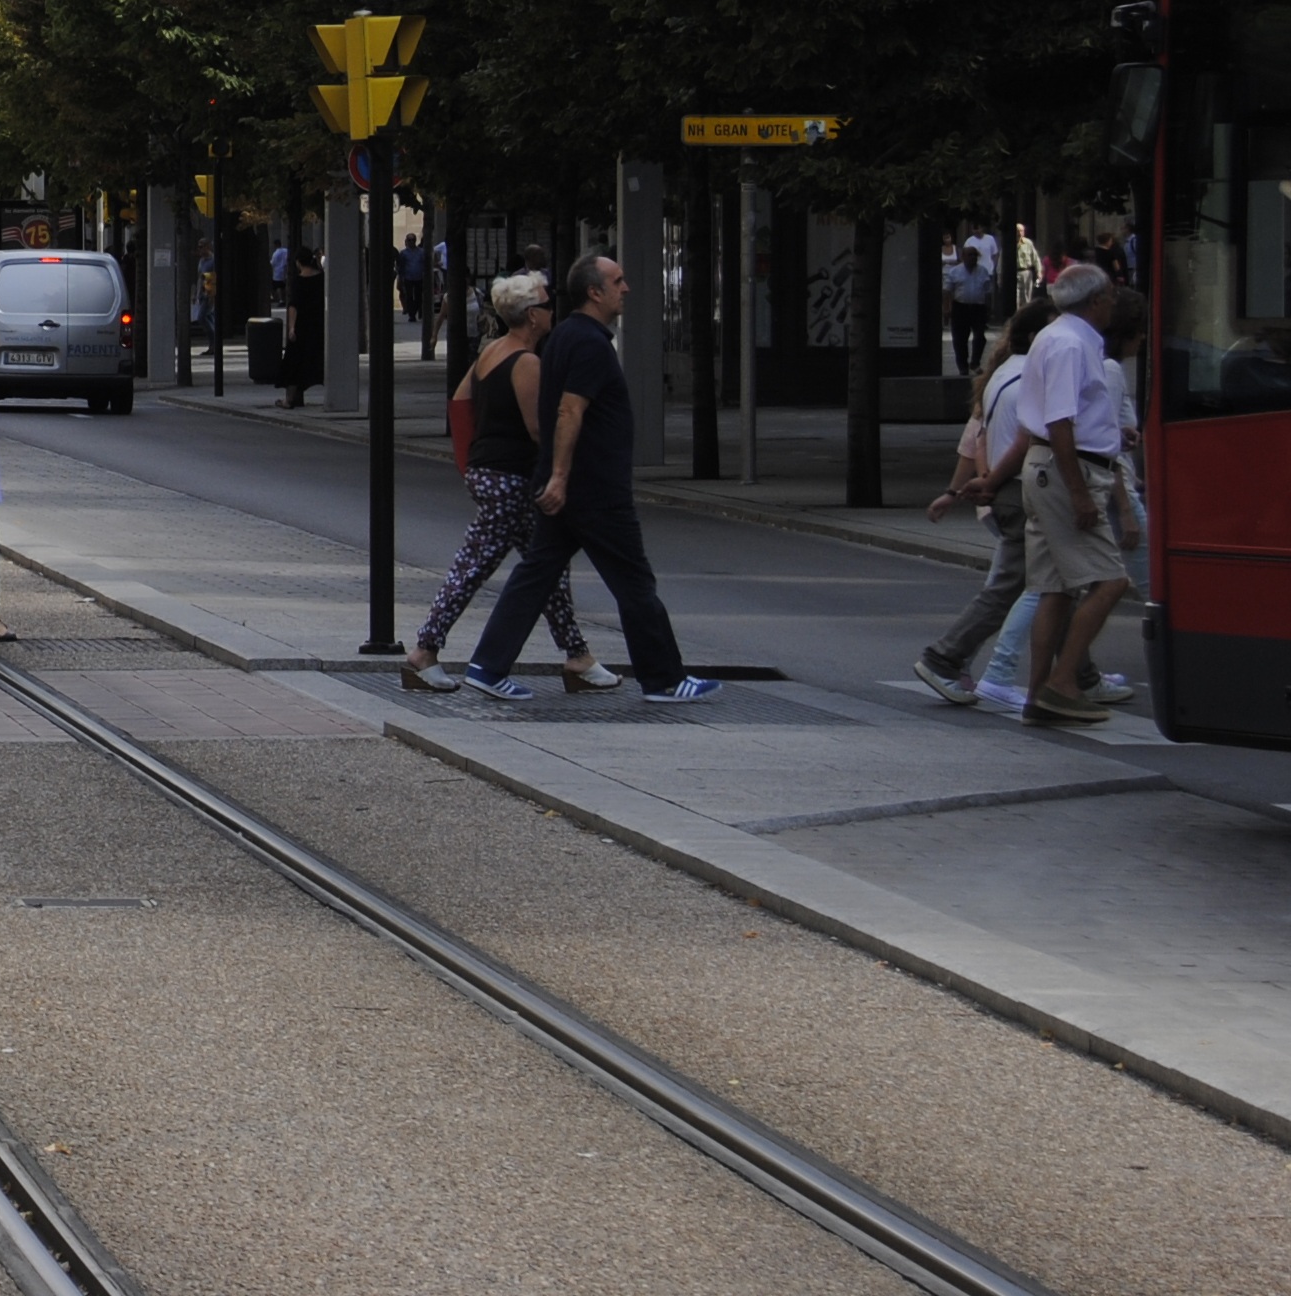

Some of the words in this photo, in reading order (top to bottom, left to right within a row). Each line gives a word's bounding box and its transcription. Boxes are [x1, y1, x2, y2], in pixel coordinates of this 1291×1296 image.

[688, 124, 704, 136] NH
[714, 124, 748, 136] GRAN
[758, 124, 794, 136] HOTEL
[26, 224, 50, 245] 75
[10, 353, 31, 362] 4313
